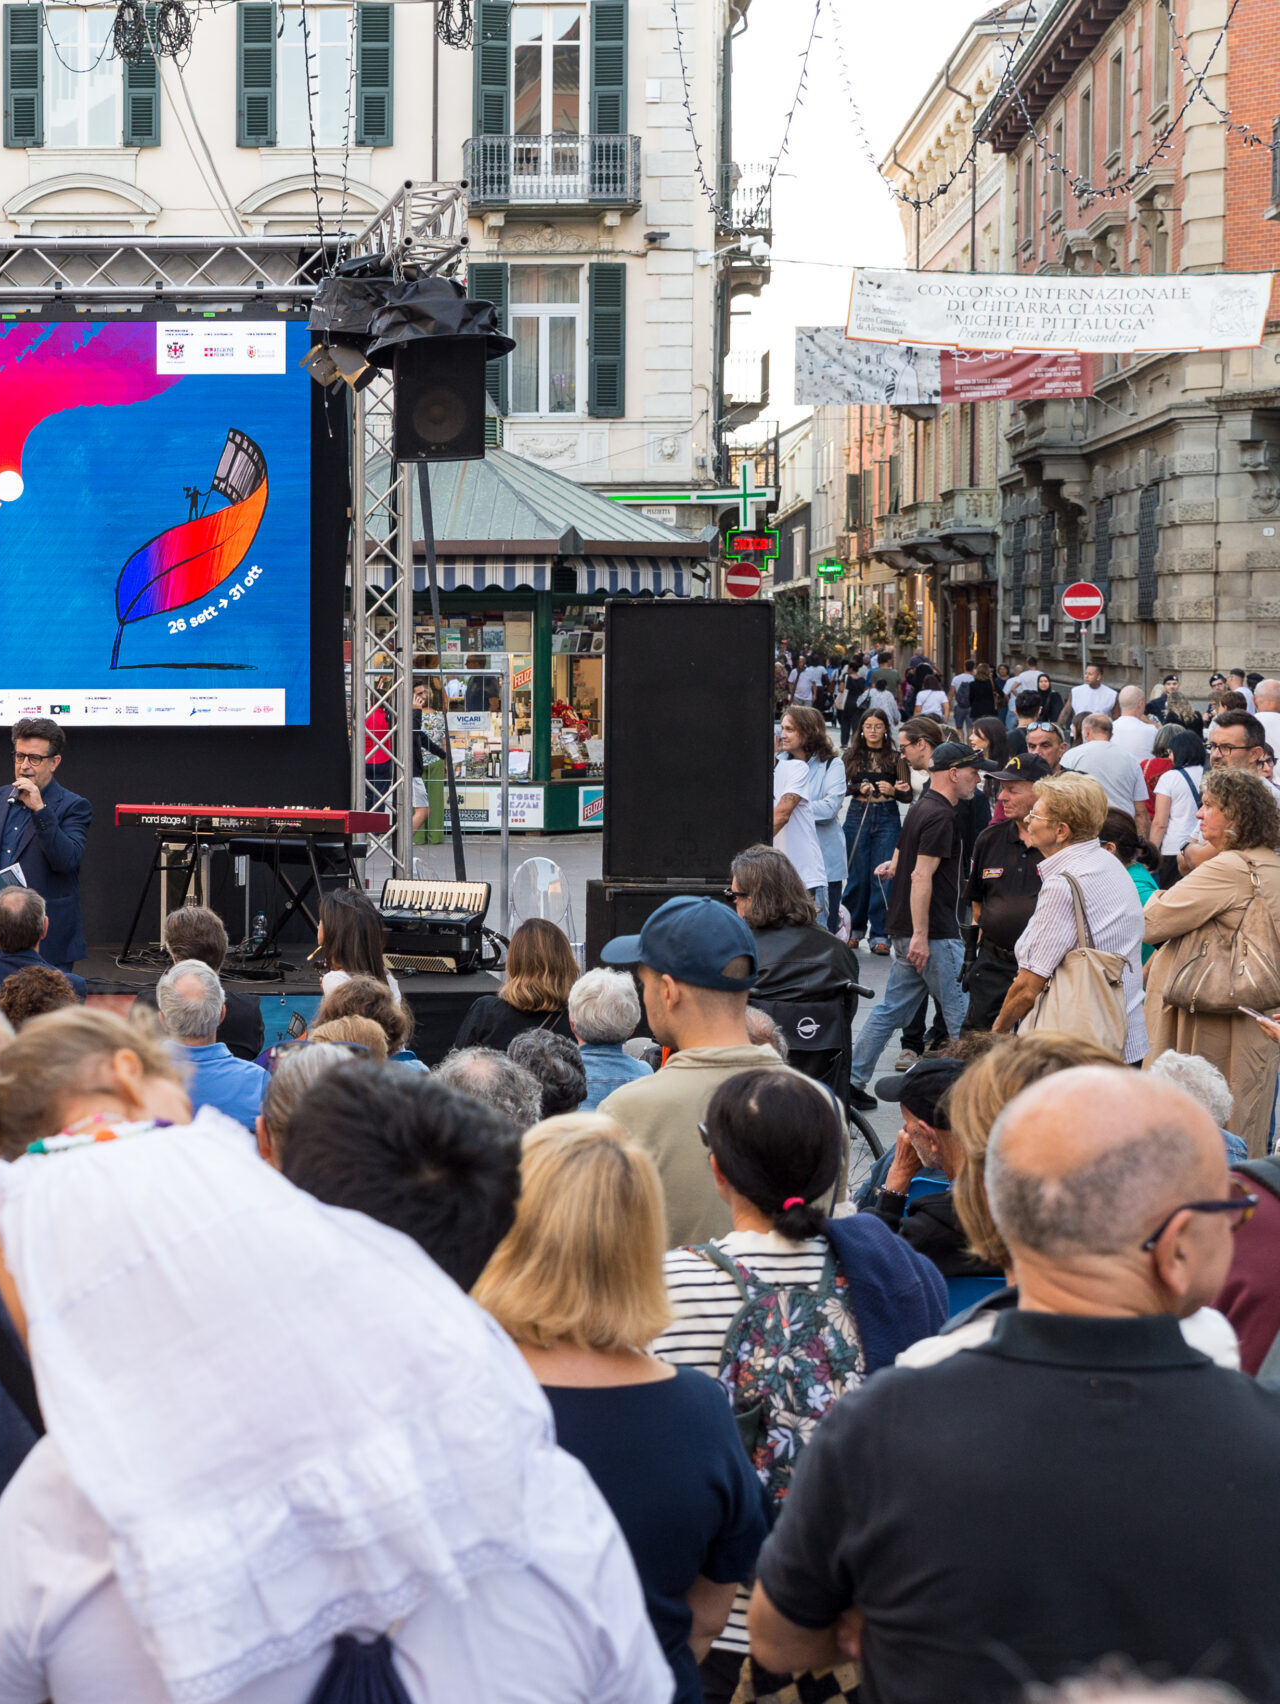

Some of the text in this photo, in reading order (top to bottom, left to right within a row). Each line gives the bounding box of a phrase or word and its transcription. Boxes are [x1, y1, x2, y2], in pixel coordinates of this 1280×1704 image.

[917, 284, 1018, 299] CONCORSO
[1024, 287, 1192, 300] INTERNAZIONALE
[947, 300, 1154, 315] DI CHITARRA CLASSICA
[958, 327, 1002, 340] Premio
[1043, 330, 1058, 342] di
[1061, 331, 1137, 344] Alessandria
[167, 565, 263, 634] 26 sett 31 ott
[497, 793, 541, 801] OTOBRE
[141, 816, 187, 826] nord stage 4
